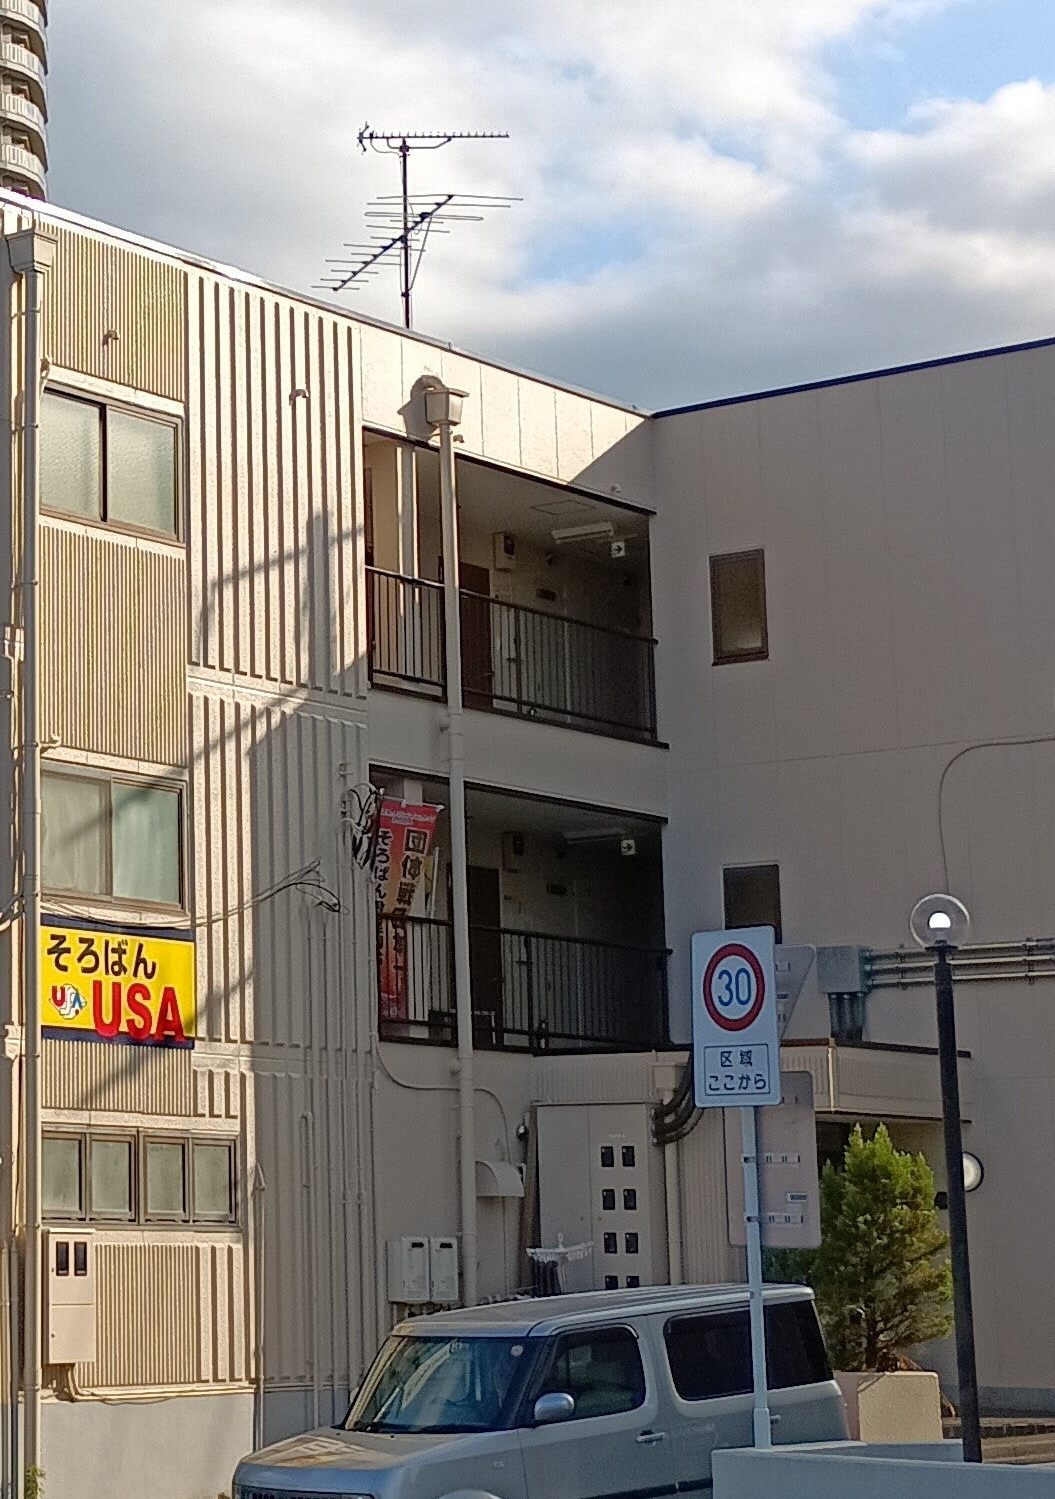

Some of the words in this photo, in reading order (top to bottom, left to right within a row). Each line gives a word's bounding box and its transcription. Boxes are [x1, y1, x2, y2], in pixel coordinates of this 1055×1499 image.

[47, 933, 157, 980] そろばん
[717, 967, 752, 1007] 30
[92, 979, 186, 1043] USA
[720, 1050, 753, 1067] 区域
[708, 1074, 767, 1091] ここから
